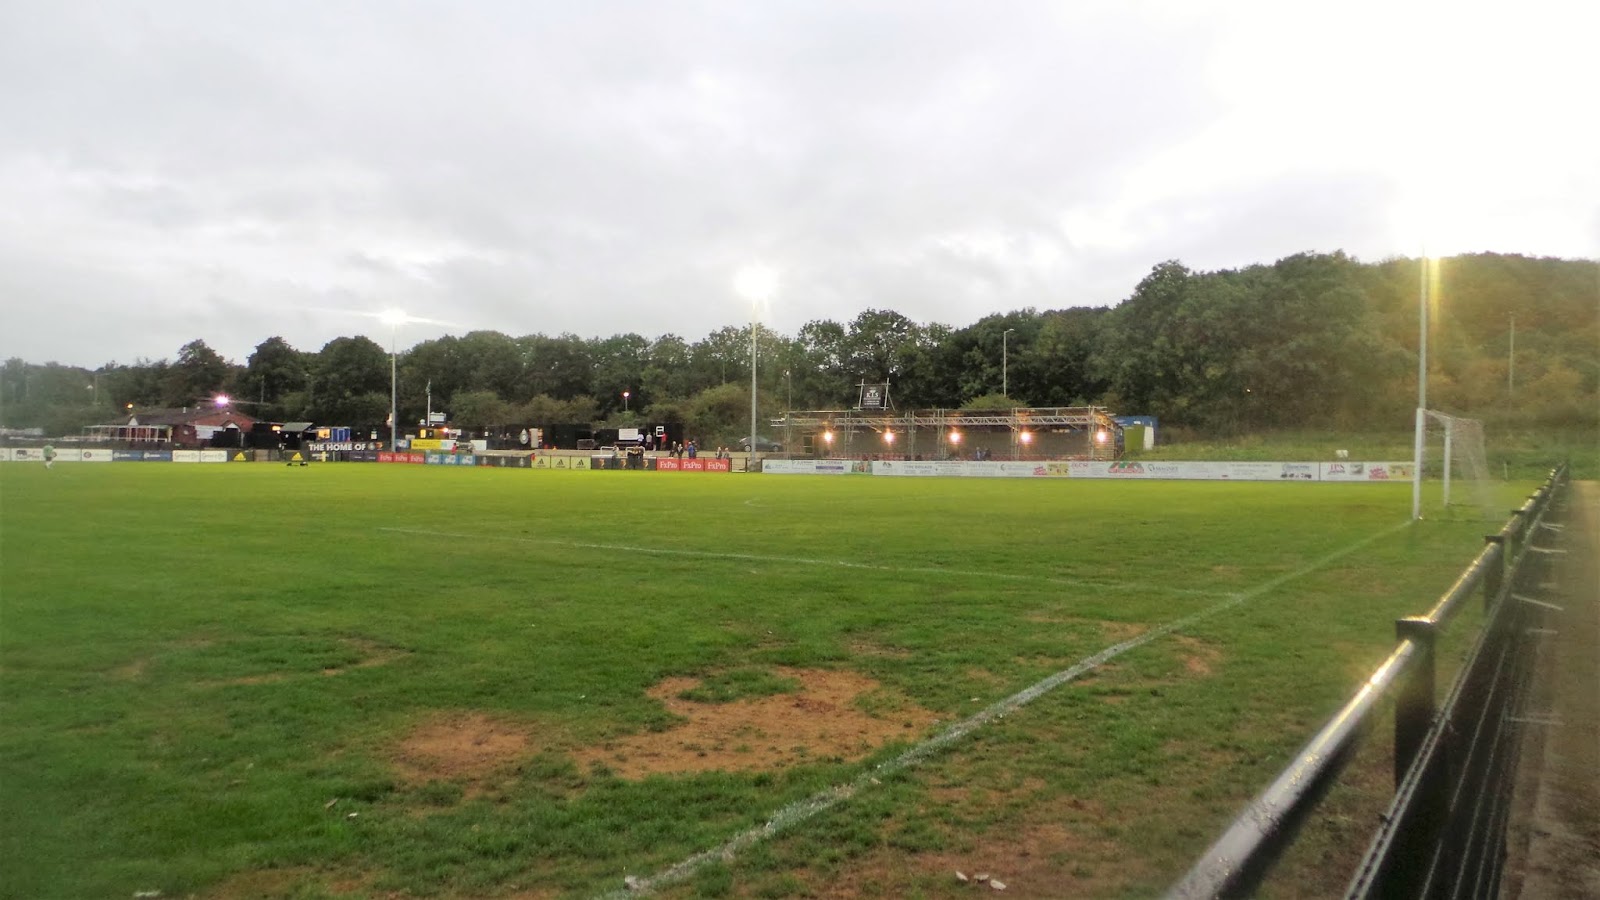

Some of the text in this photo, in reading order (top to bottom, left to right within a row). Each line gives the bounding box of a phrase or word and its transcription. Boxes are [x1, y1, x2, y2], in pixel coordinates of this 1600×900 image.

[326, 443, 352, 451] HOME
[354, 443, 366, 451] OF
[708, 462, 726, 470] FxPro
